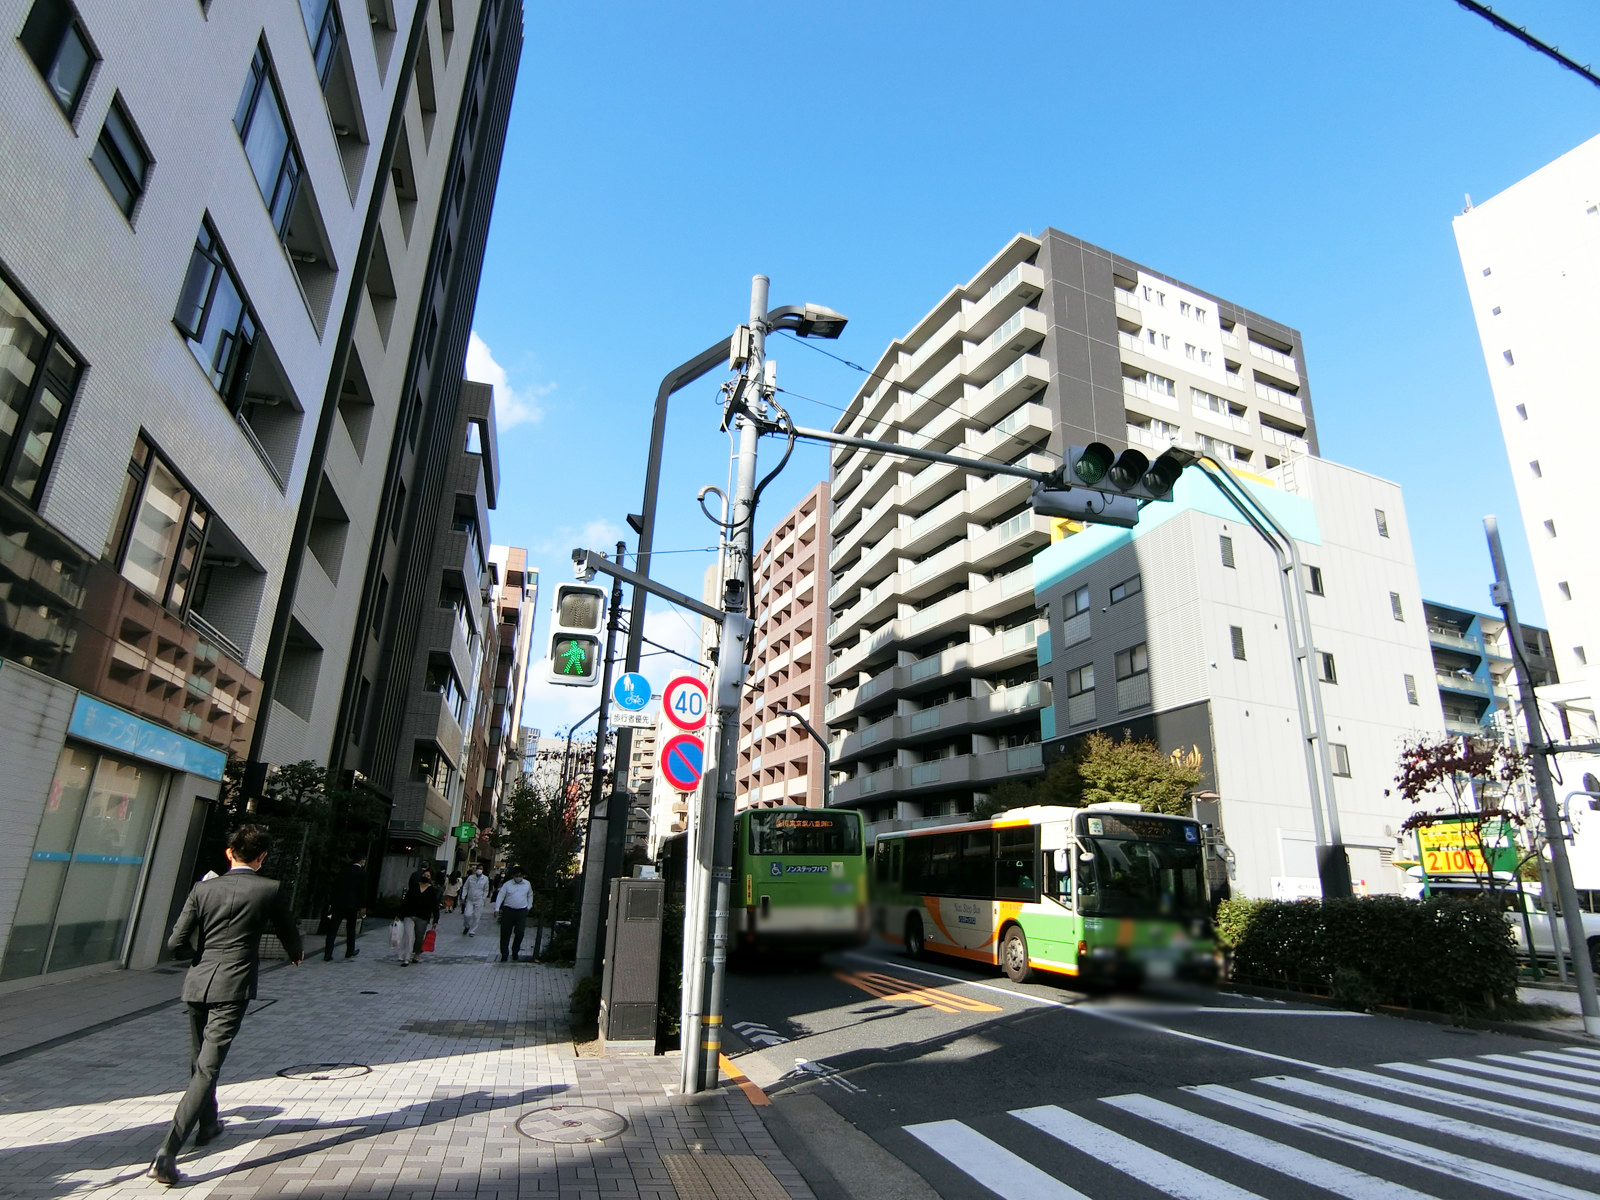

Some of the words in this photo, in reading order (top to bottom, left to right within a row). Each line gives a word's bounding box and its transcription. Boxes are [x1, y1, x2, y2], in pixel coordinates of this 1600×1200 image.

[675, 691, 702, 715] 40
[613, 713, 650, 724] 歩行者優先
